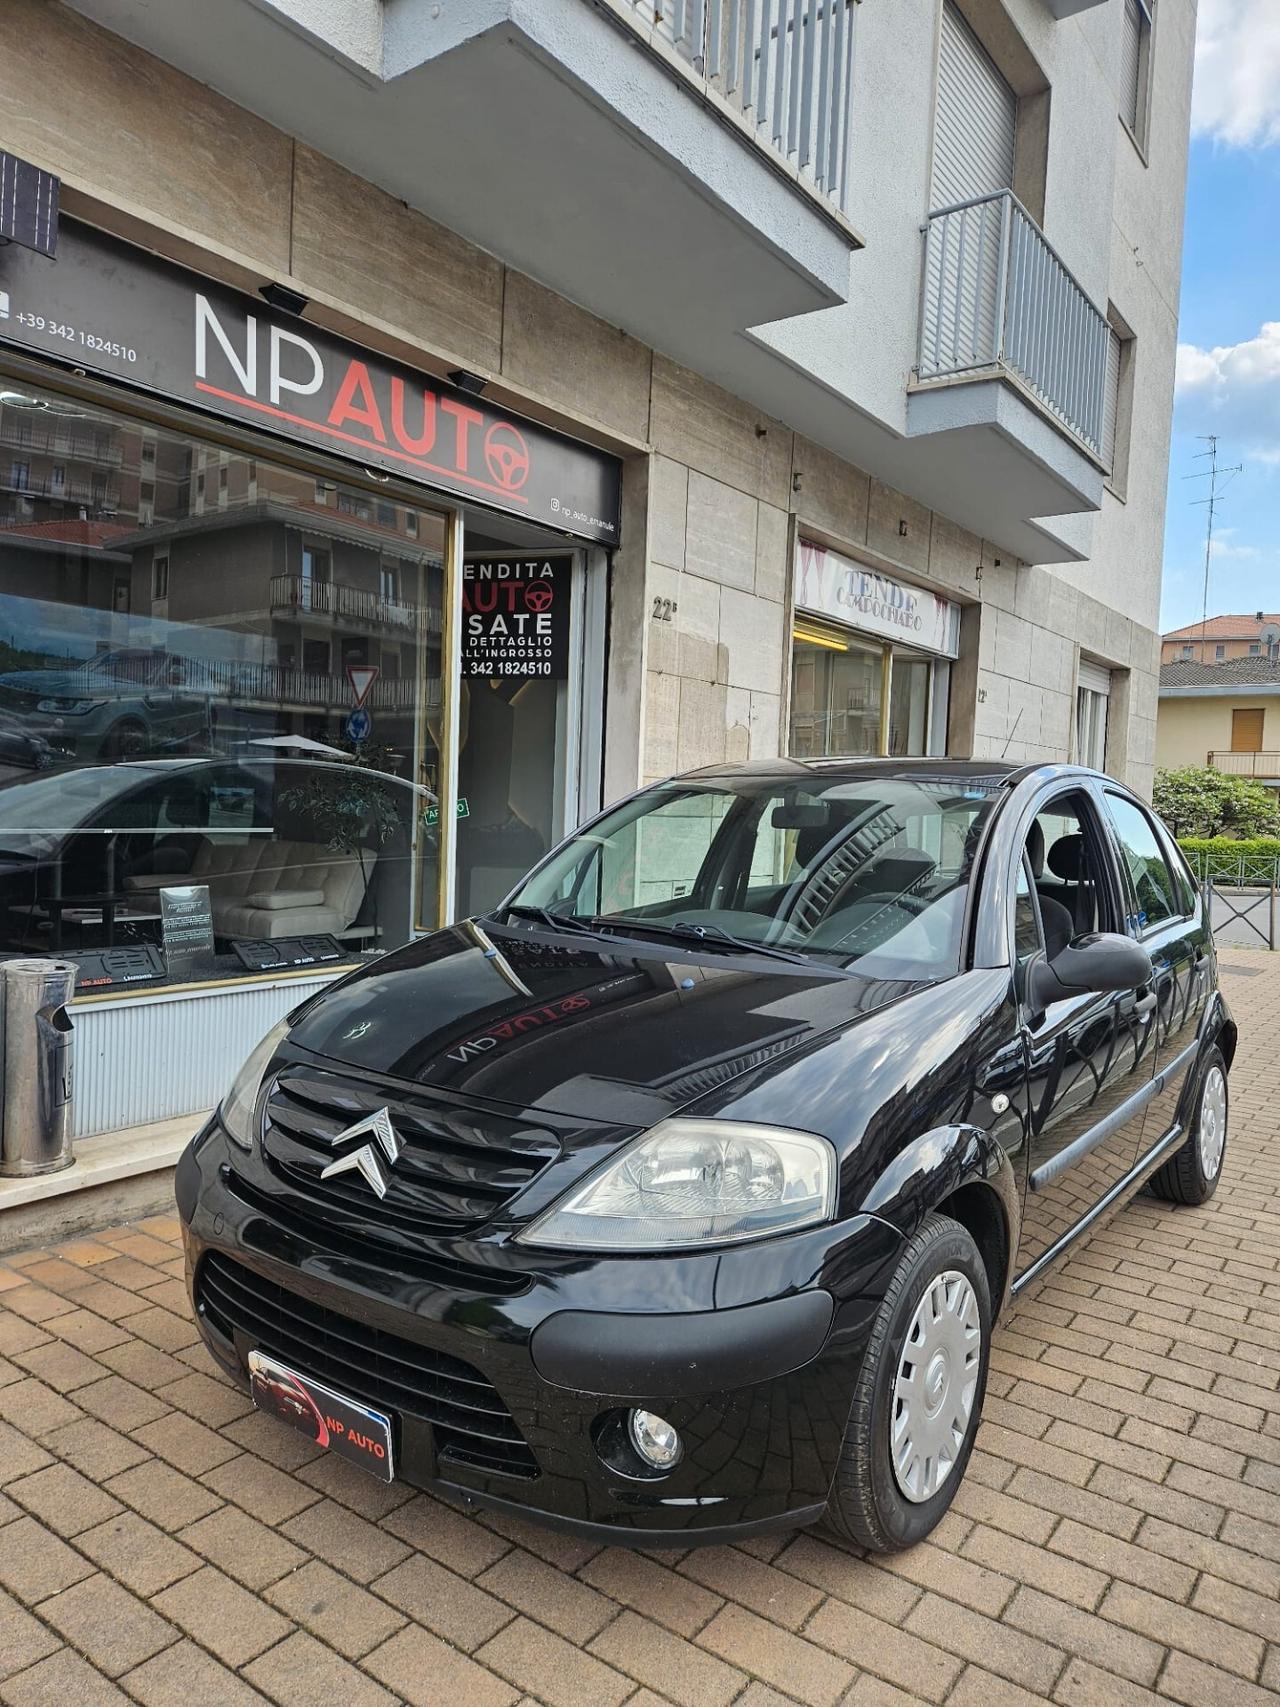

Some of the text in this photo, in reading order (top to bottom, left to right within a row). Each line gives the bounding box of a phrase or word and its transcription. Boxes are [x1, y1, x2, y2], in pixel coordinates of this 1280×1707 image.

[16, 312, 137, 362] +39 342 1824510
[463, 561, 554, 580] ENDITA
[845, 569, 918, 612] TENDE
[467, 613, 553, 635] SATE
[469, 636, 553, 647] DETTAGLIO
[470, 661, 493, 675] 342
[497, 660, 552, 675] 1824510
[326, 1416, 385, 1458] NP AUTO
